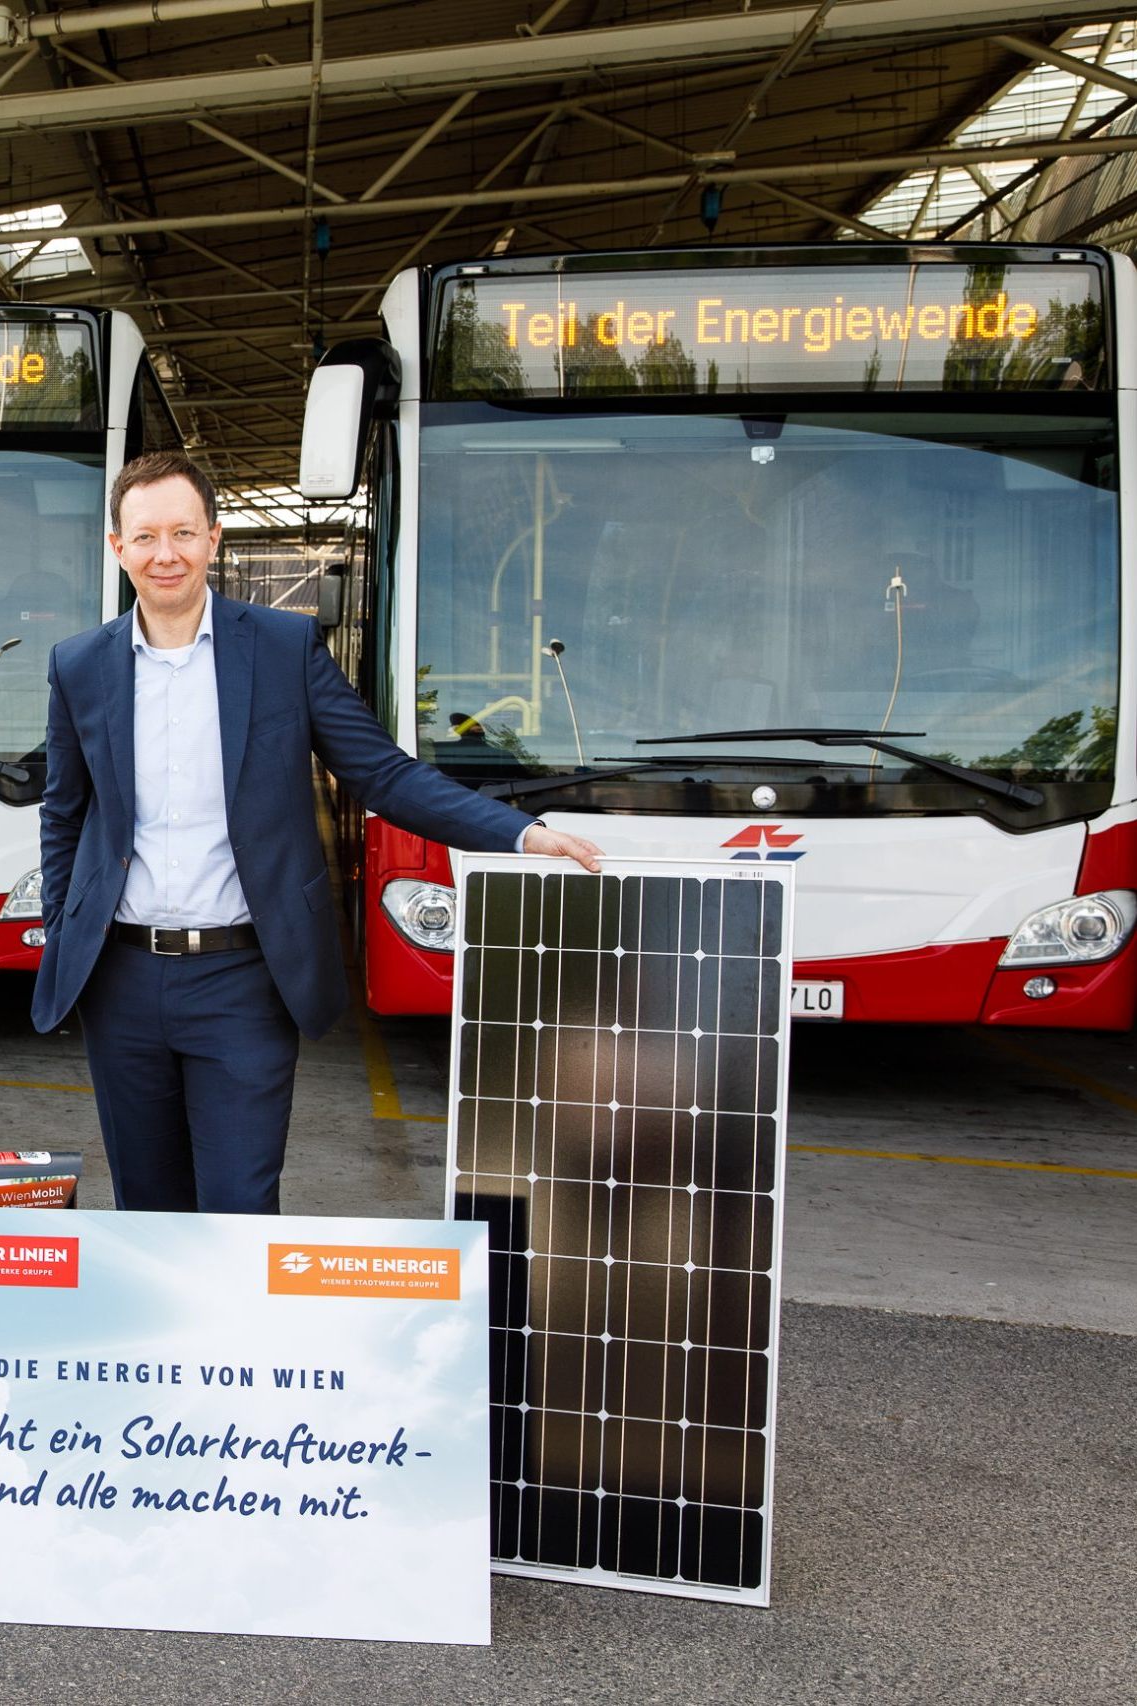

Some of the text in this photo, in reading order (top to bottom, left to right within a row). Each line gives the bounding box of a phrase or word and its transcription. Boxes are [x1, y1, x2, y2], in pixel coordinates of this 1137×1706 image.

[501, 292, 1038, 353] Teil der Energiewende
[1, 1186, 64, 1202] WienMobil
[9, 1247, 68, 1263] LINIEN
[319, 1256, 449, 1275] WIEN ENERGIE
[353, 1279, 405, 1287] STADTWERKE
[408, 1281, 440, 1289] GRUPPE
[57, 1360, 182, 1385] ENERGIE
[200, 1366, 254, 1387] VON
[273, 1368, 345, 1390] WIEN
[49, 1421, 102, 1453] ein
[56, 1470, 118, 1509] alle
[132, 1475, 281, 1516] machen
[299, 1486, 369, 1520] mit.
